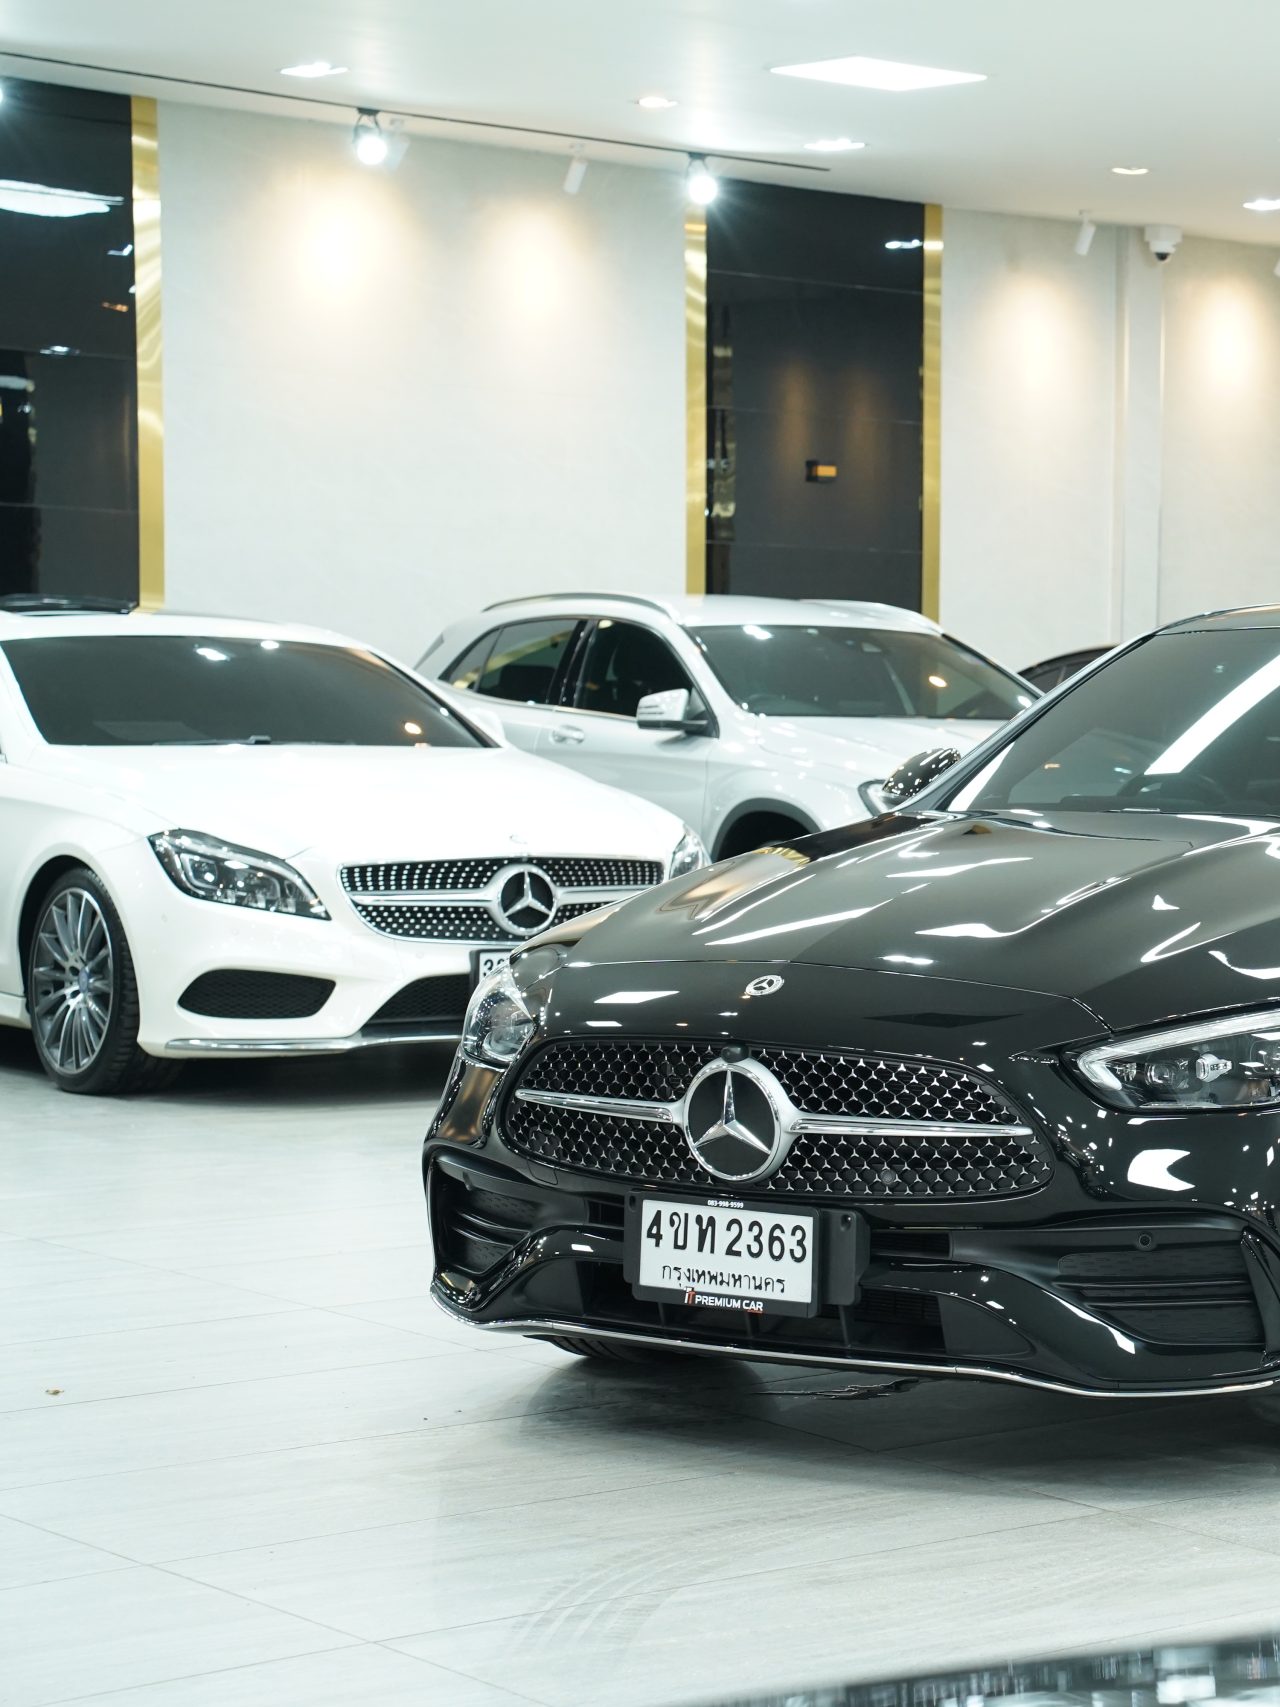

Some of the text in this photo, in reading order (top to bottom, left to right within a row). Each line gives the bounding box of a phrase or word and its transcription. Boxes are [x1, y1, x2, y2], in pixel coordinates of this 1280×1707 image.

[725, 1218, 807, 1263] 2363
[662, 1264, 786, 1293] กรุงเทพมหานคร
[695, 1294, 741, 1309] PREMIUM
[742, 1299, 764, 1311] CAR
